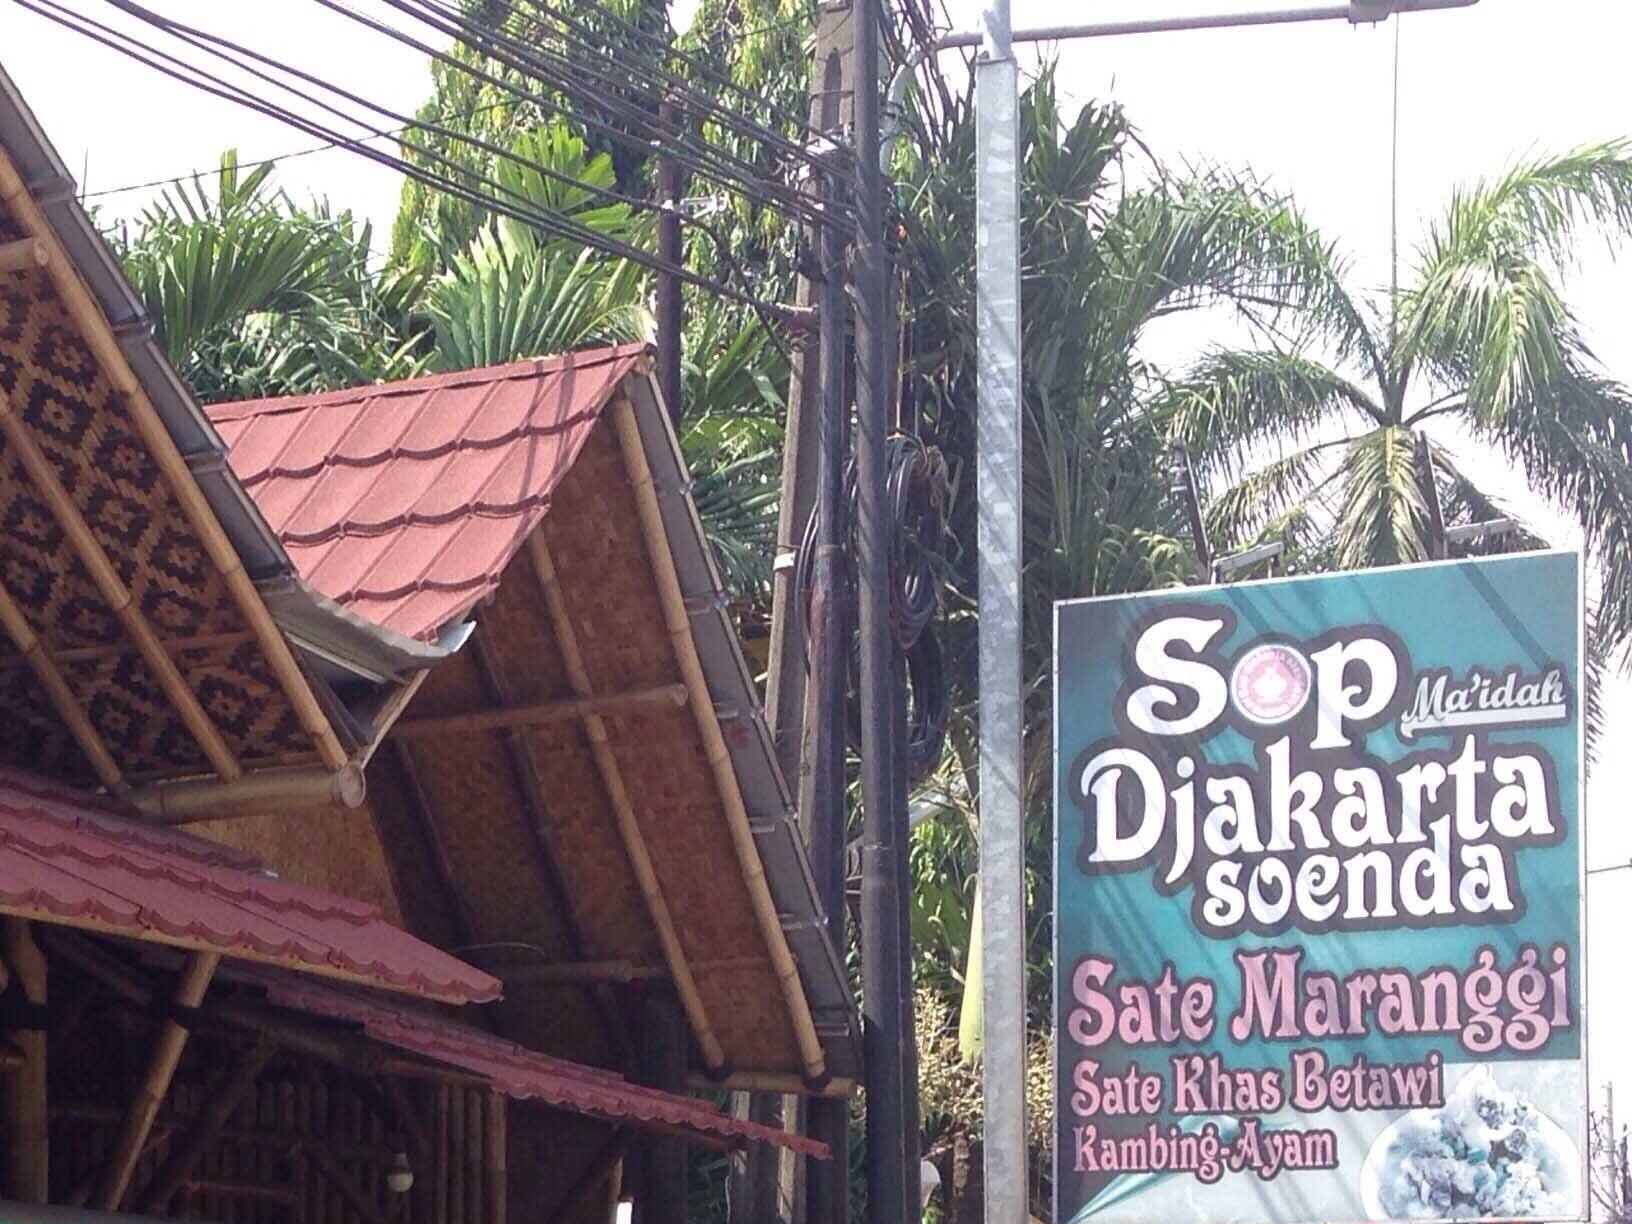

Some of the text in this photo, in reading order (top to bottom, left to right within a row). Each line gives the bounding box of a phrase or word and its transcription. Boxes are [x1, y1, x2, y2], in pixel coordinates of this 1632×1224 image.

[1126, 616, 1398, 749] Sop
[1080, 735, 1555, 885] Djakarta
[1202, 815, 1514, 927] soenda
[1068, 946, 1571, 1051] Sate Maranggi
[1072, 1050, 1445, 1117] Sate Khas Betawi
[1073, 1120, 1335, 1180] Kambing-Ayam
